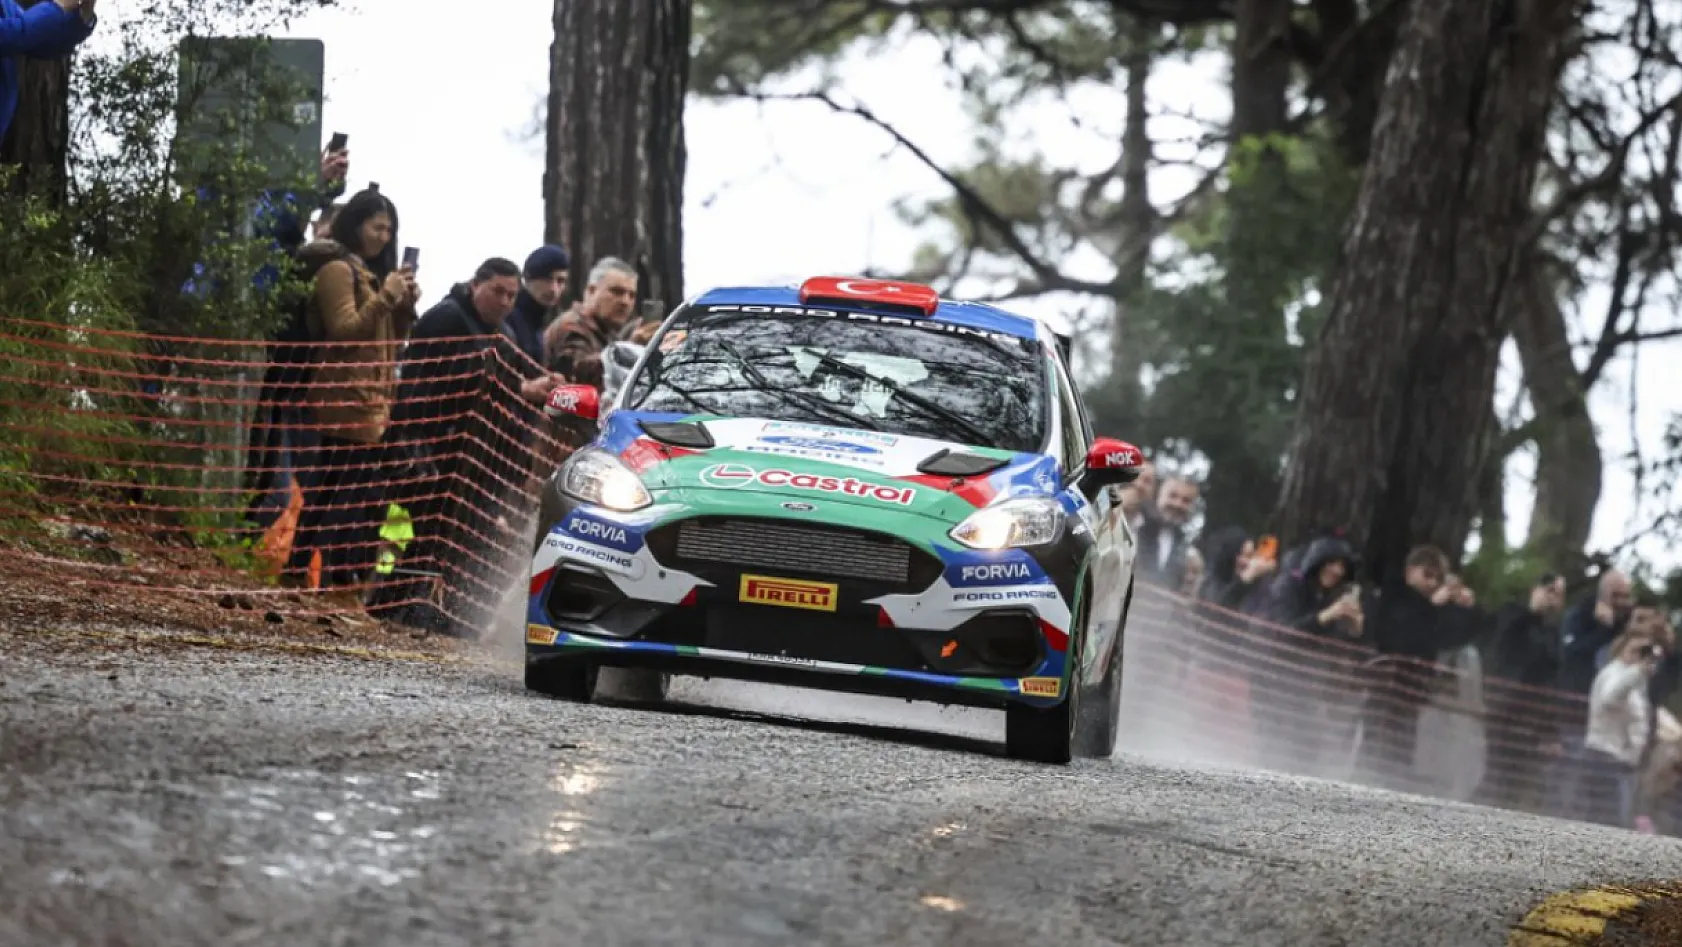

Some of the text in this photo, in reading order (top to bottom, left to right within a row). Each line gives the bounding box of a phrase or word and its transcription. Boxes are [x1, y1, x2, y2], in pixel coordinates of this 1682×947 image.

[1105, 450, 1135, 466] NGK
[758, 469, 914, 505] Castrol
[569, 517, 627, 545] FORVIA
[576, 546, 632, 568] RACING
[962, 562, 1031, 581] FORVIA
[747, 579, 831, 606] PIRELLI
[953, 590, 1057, 602] FORD RACING
